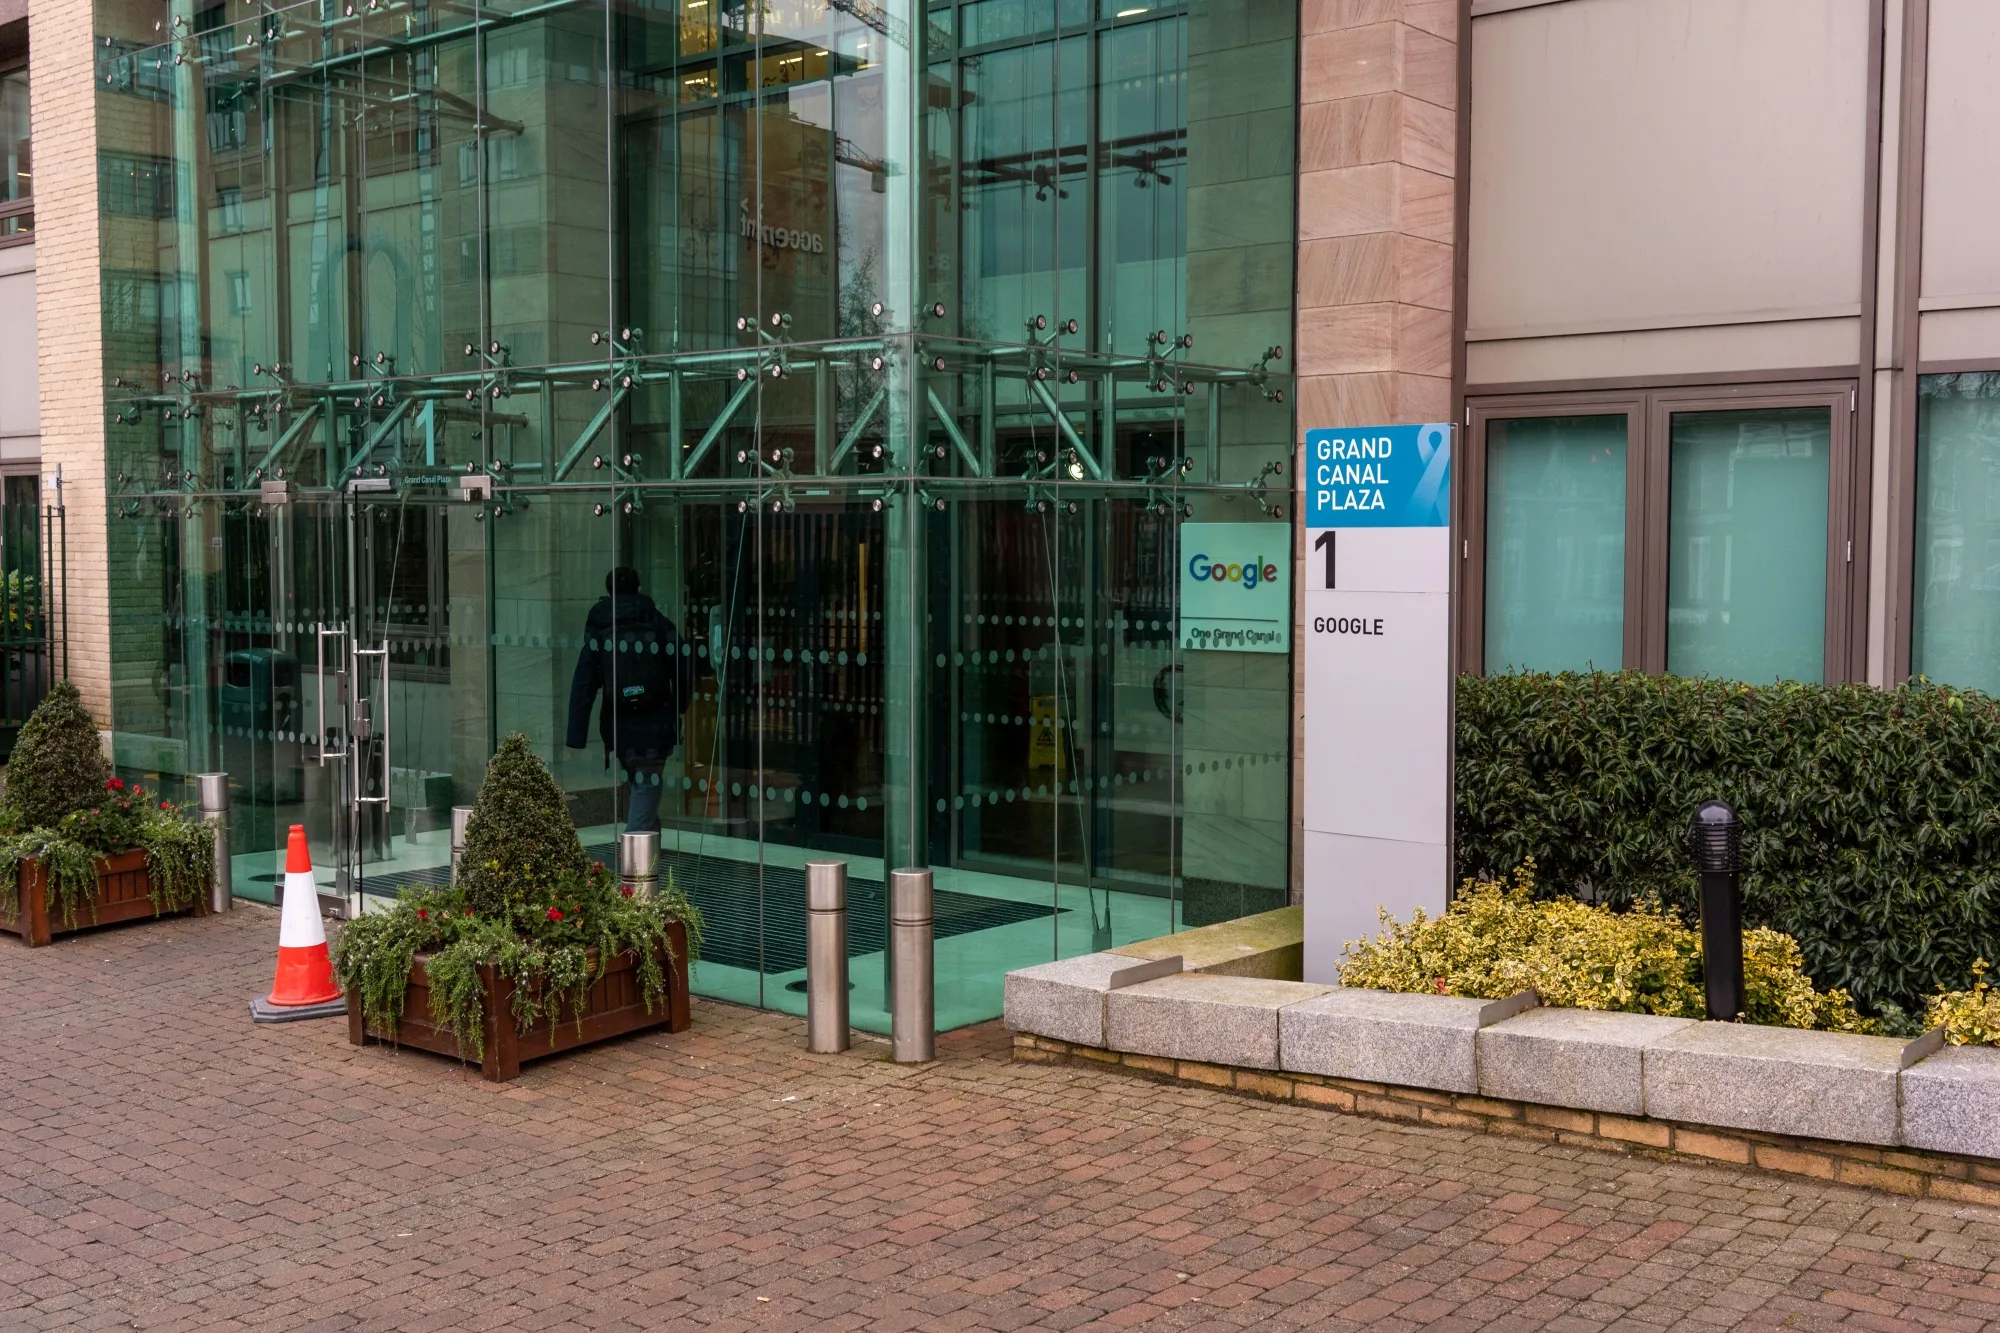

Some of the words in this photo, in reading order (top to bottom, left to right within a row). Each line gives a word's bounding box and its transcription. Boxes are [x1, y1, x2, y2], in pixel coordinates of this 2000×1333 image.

[415, 399, 435, 466] 1
[1316, 437, 1392, 460] GRAND
[404, 475, 421, 484] Grand
[421, 475, 437, 484] Canal
[437, 475, 452, 483] Plaza
[1316, 463, 1389, 486] CANAL
[1317, 489, 1386, 511] PLAZA
[1314, 530, 1336, 589] 1
[1189, 553, 1278, 590] Google
[1191, 628, 1212, 639] One
[1314, 616, 1384, 636] GOOGLE
